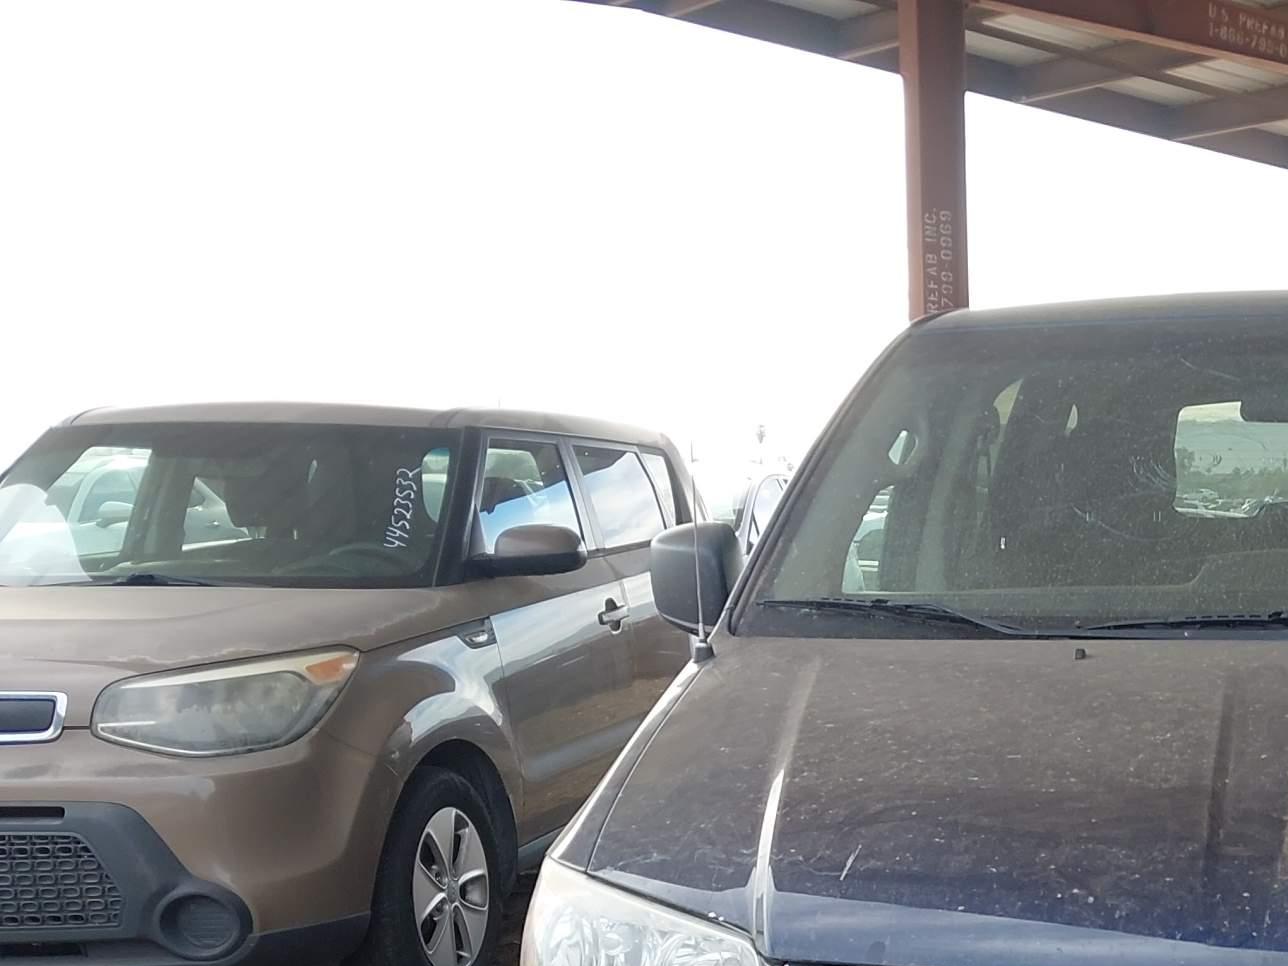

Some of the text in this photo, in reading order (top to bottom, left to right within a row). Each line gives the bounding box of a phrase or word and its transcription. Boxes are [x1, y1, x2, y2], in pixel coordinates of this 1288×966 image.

[925, 253, 939, 315] REFAB
[939, 210, 954, 308] 799-0969
[384, 467, 421, 548] 44523532
